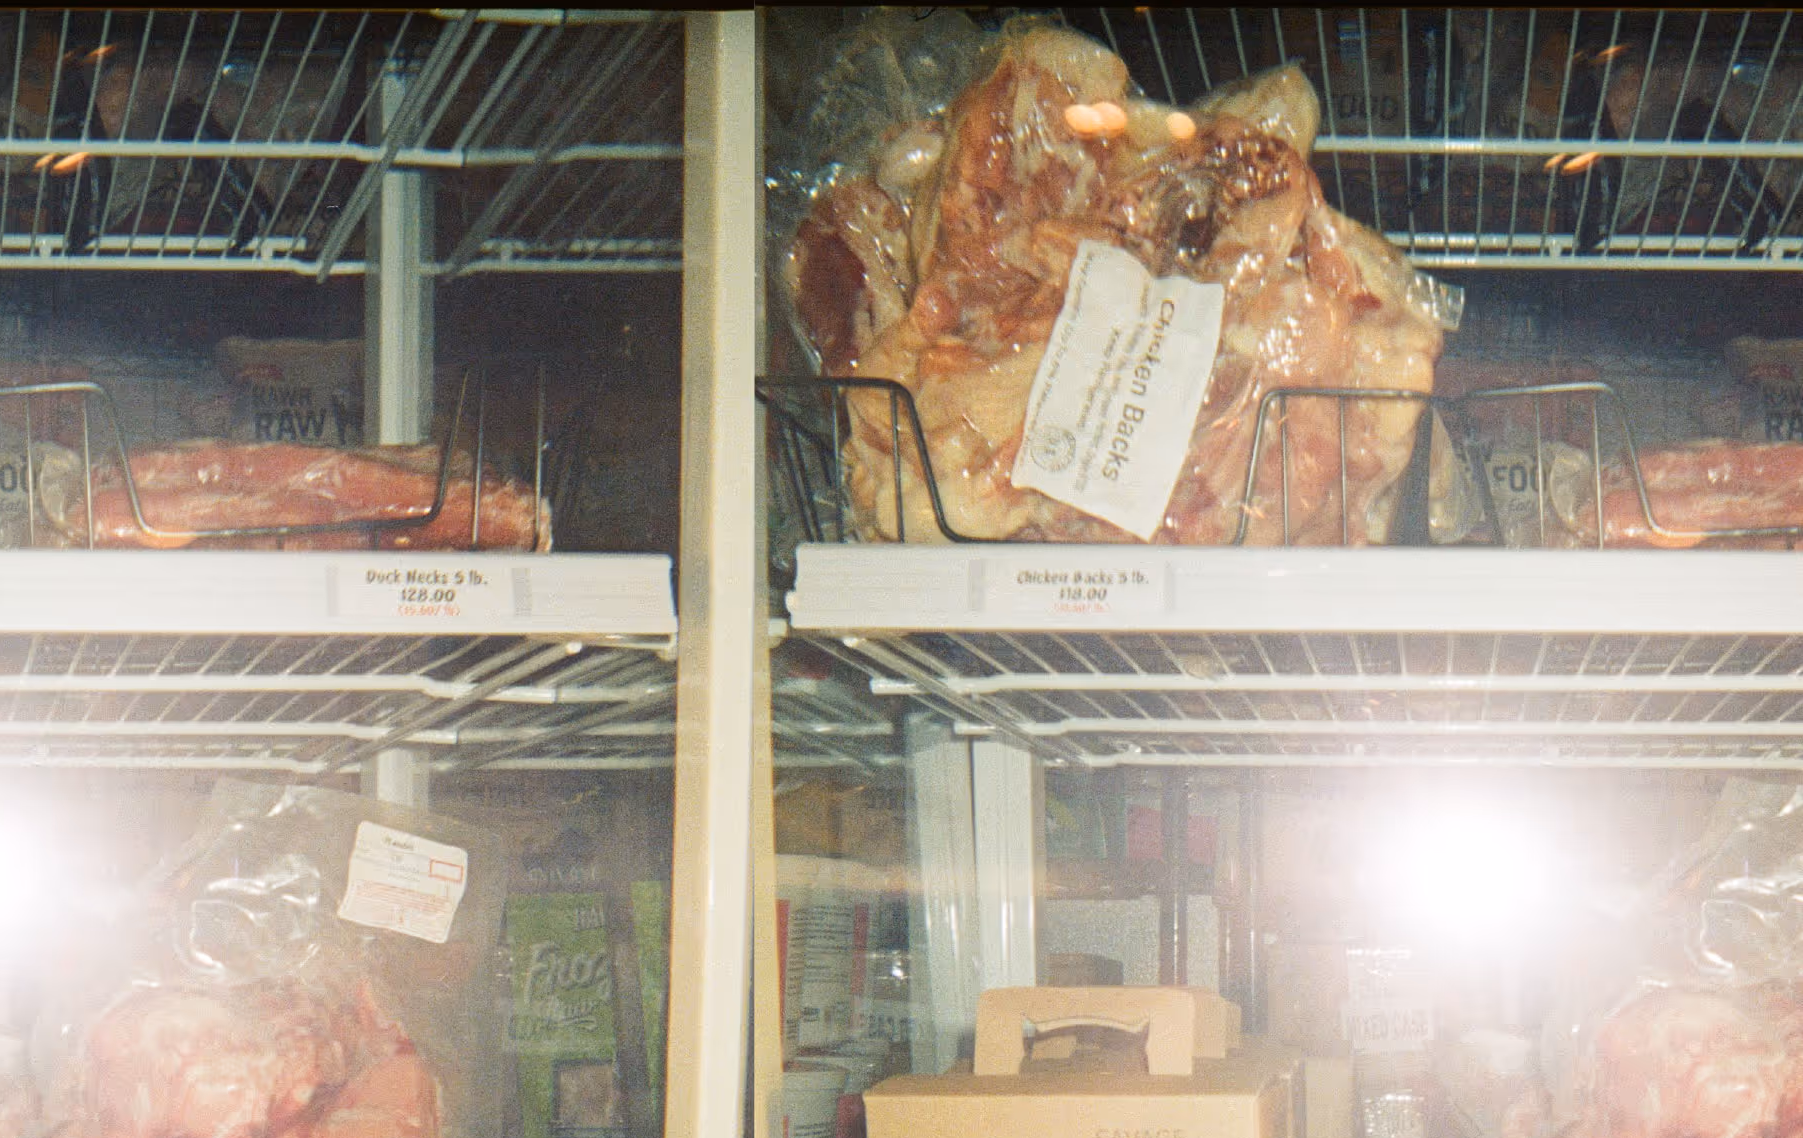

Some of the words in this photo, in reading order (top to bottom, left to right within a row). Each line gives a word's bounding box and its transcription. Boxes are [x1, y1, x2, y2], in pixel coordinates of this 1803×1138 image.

[1131, 298, 1175, 398] Chicken
[255, 408, 327, 441] RAW
[1102, 405, 1146, 482] Backs
[1492, 463, 1548, 493] FOO
[365, 568, 401, 585] Duck
[406, 568, 448, 585] Necks
[454, 569, 465, 585] 5
[469, 568, 489, 586] lb.
[1017, 569, 1068, 585] Chicken
[1073, 569, 1114, 585] Backs
